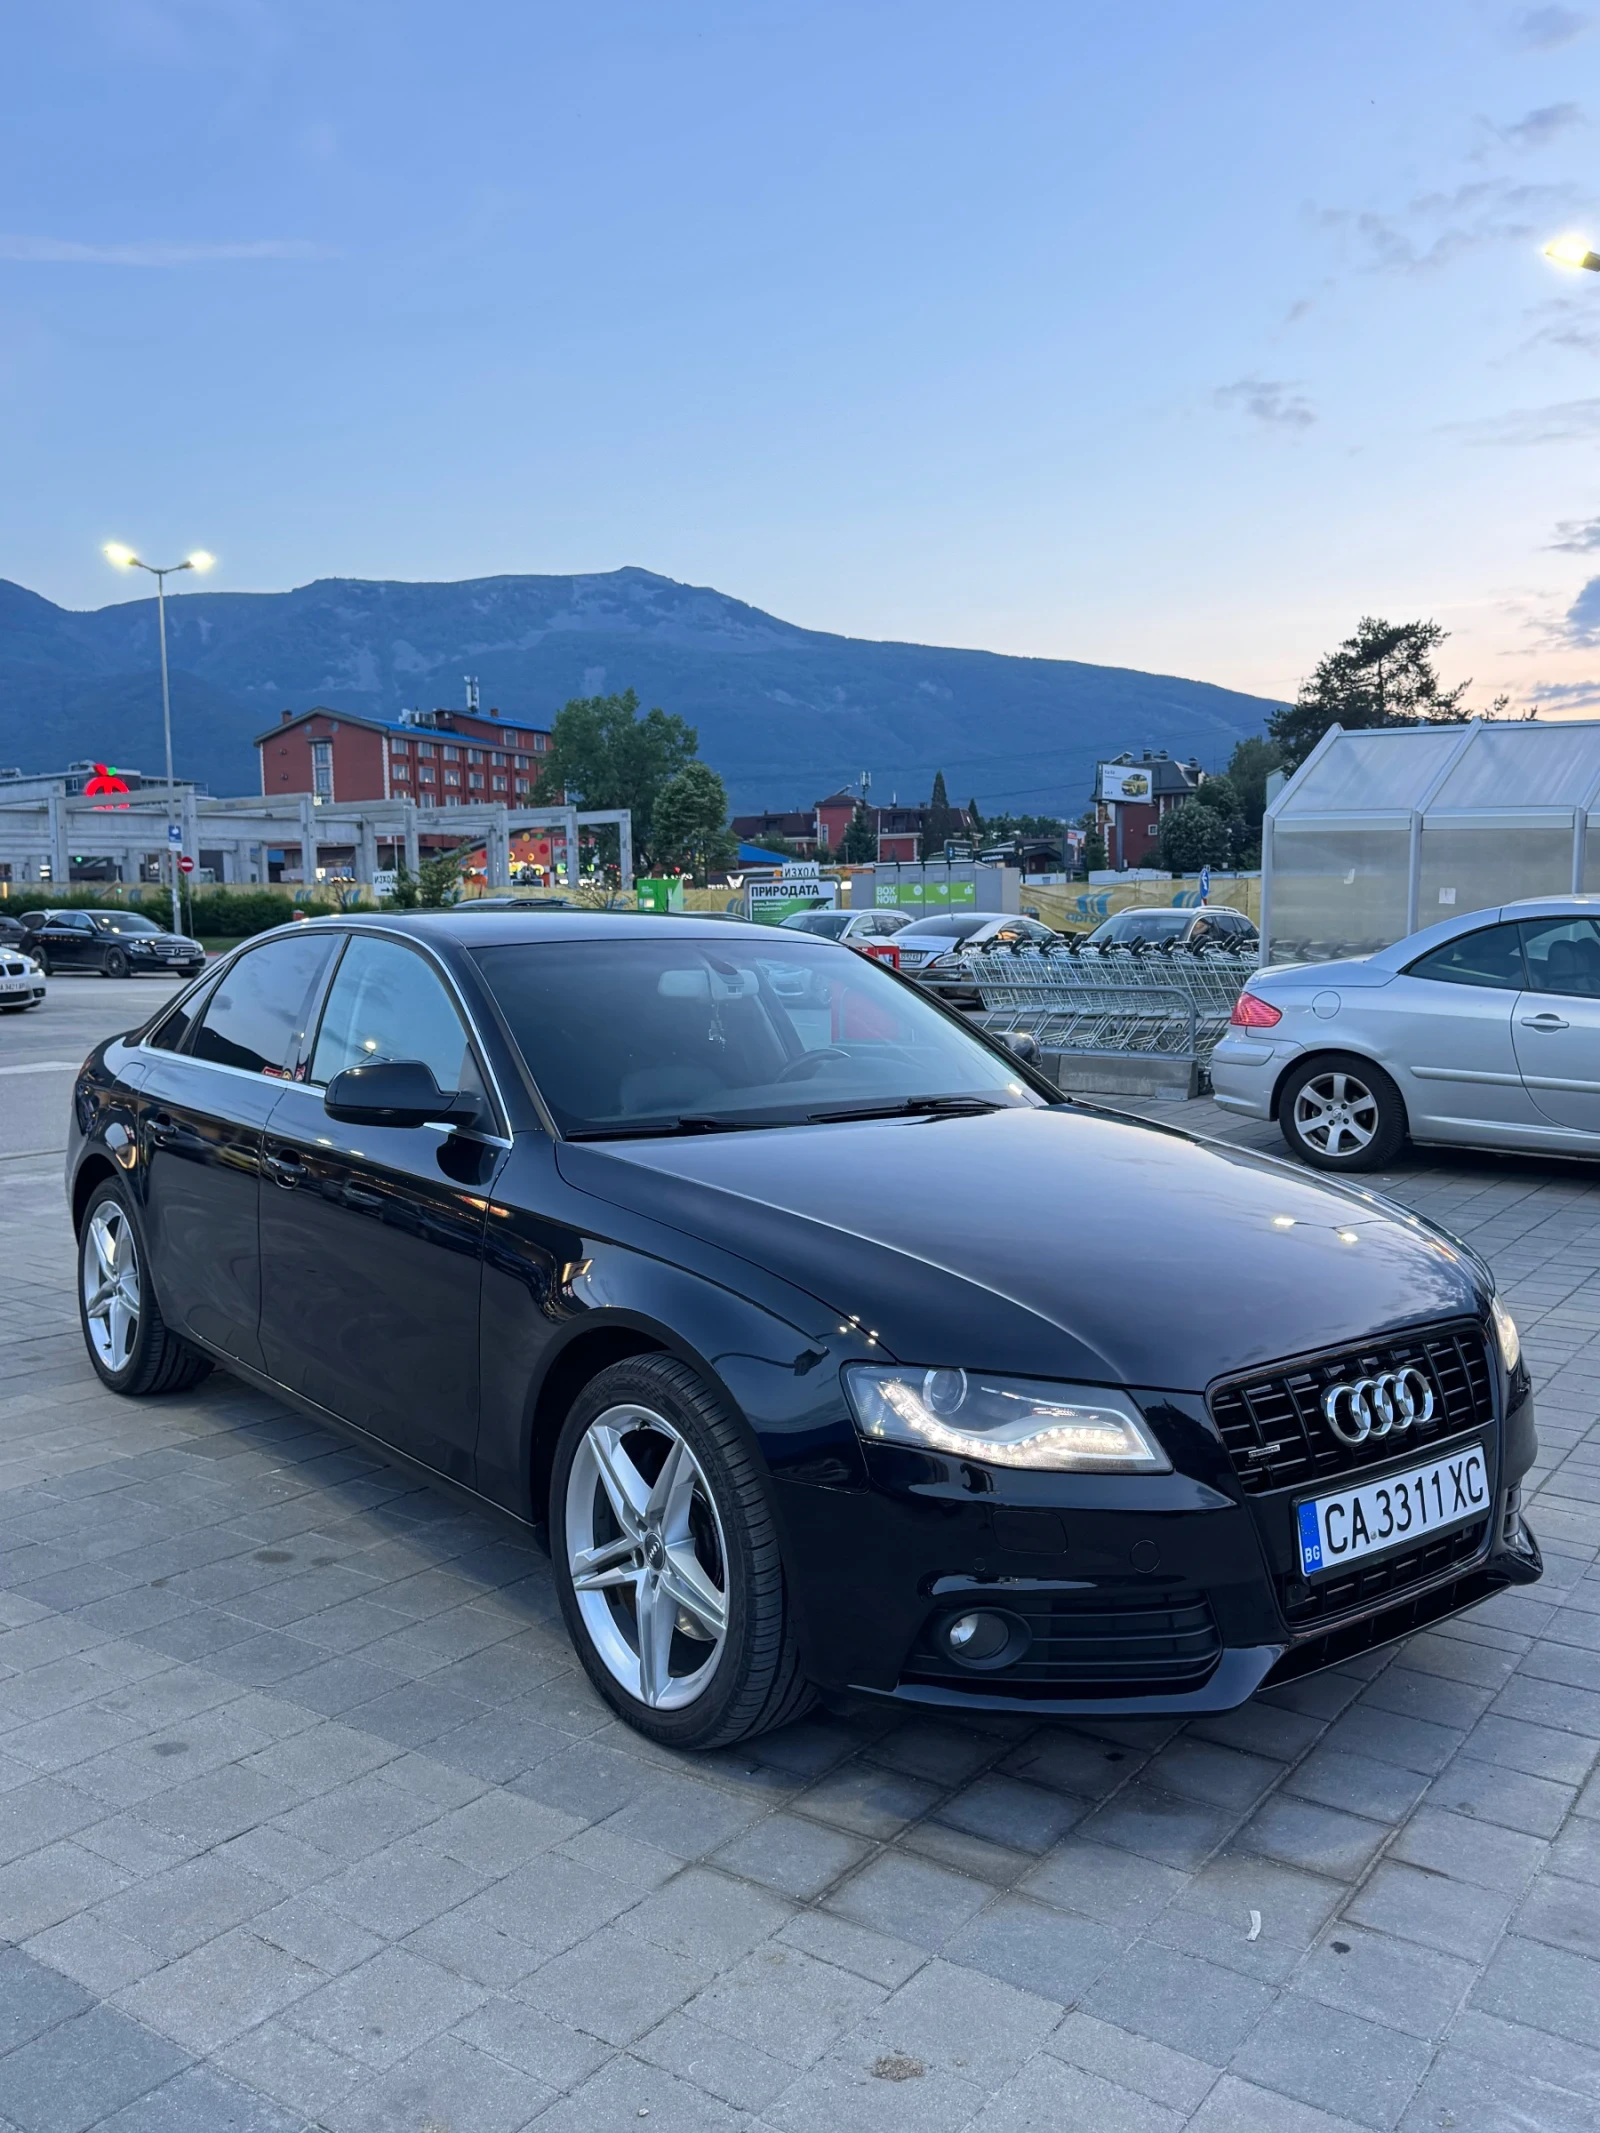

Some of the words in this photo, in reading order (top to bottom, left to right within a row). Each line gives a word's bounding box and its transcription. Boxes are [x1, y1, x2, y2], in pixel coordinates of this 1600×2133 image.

[751, 884, 820, 898] ПРИРОДАТА
[876, 886, 896, 895] BOX
[876, 895, 898, 904] NOW
[1324, 1497, 1371, 1554] CA
[1376, 1470, 1444, 1538] 3311
[1448, 1456, 1484, 1513] XC
[1304, 1545, 1321, 1564] BG
